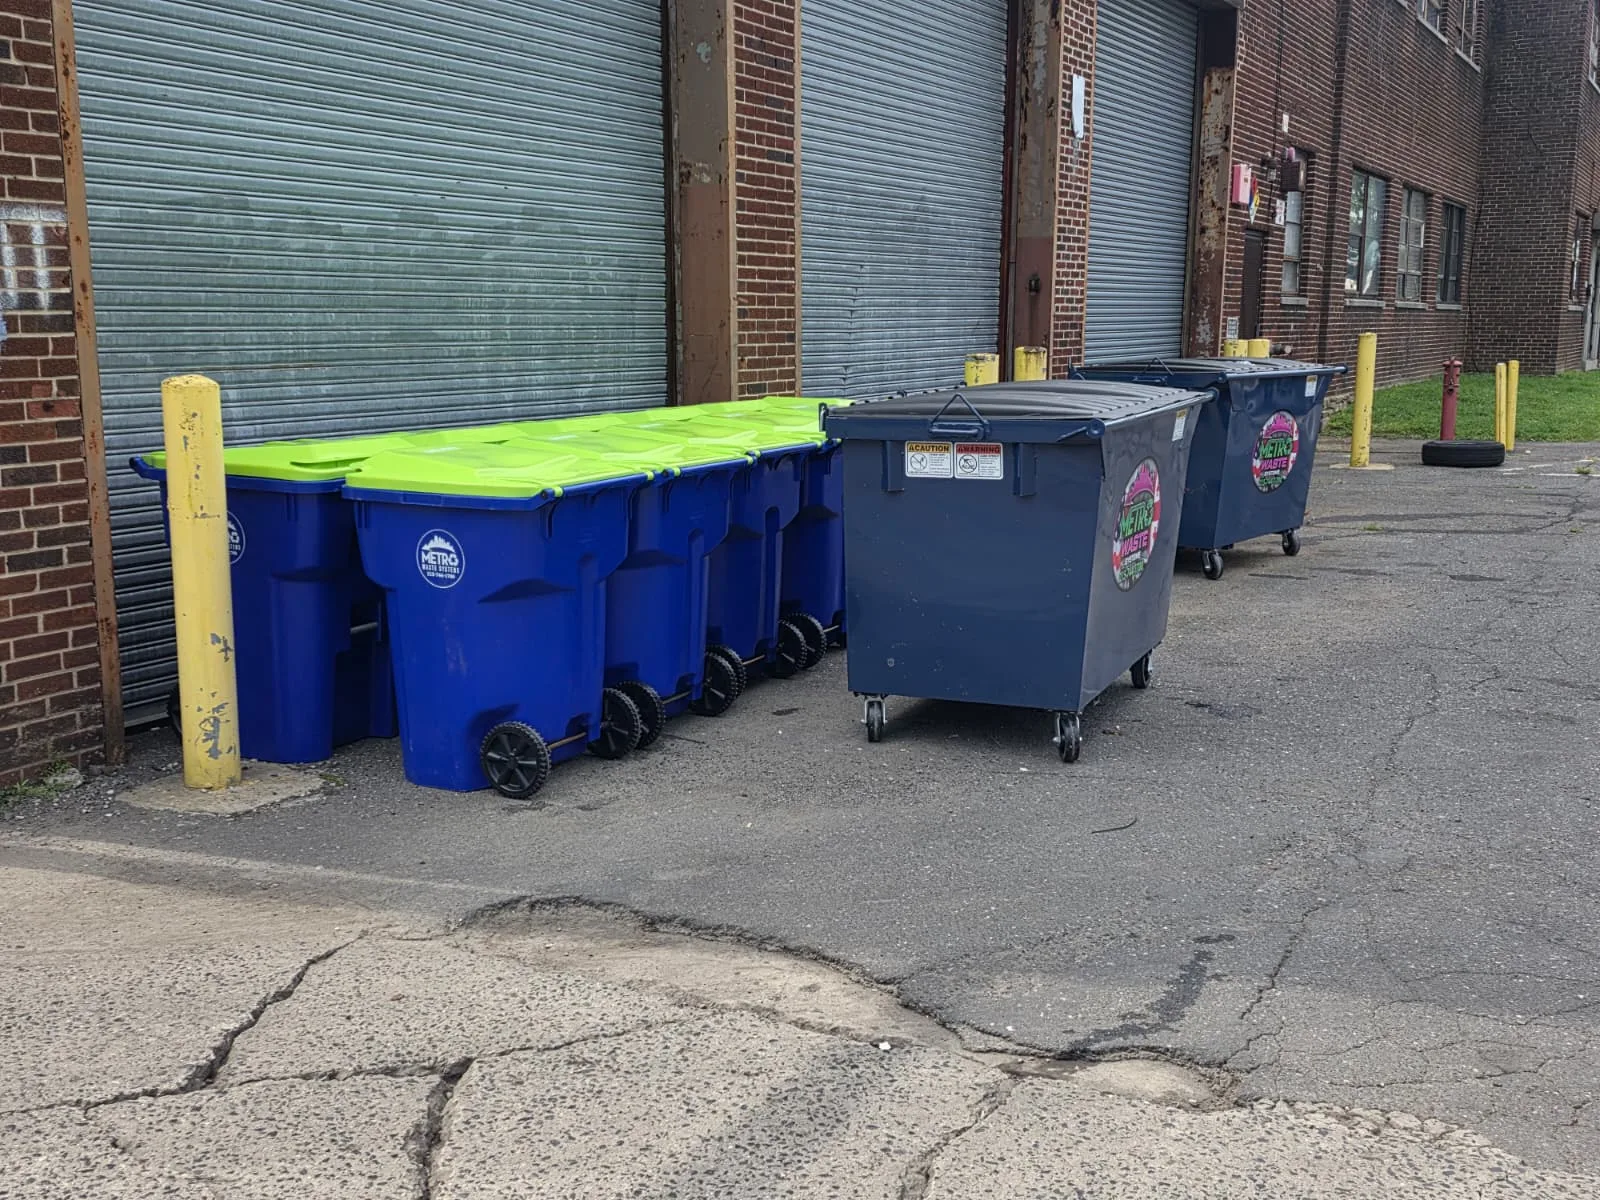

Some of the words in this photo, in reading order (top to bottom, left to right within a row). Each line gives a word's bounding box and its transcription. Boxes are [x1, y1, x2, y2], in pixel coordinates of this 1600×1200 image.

[913, 444, 950, 452] CAUTION
[963, 445, 1000, 454] WARNING
[1260, 437, 1292, 458] METRO
[1261, 457, 1288, 471] WASTE
[1120, 499, 1153, 537] METRO
[1120, 531, 1149, 557] WASTE
[421, 551, 459, 566] METRO
[421, 563, 437, 571] WASTE
